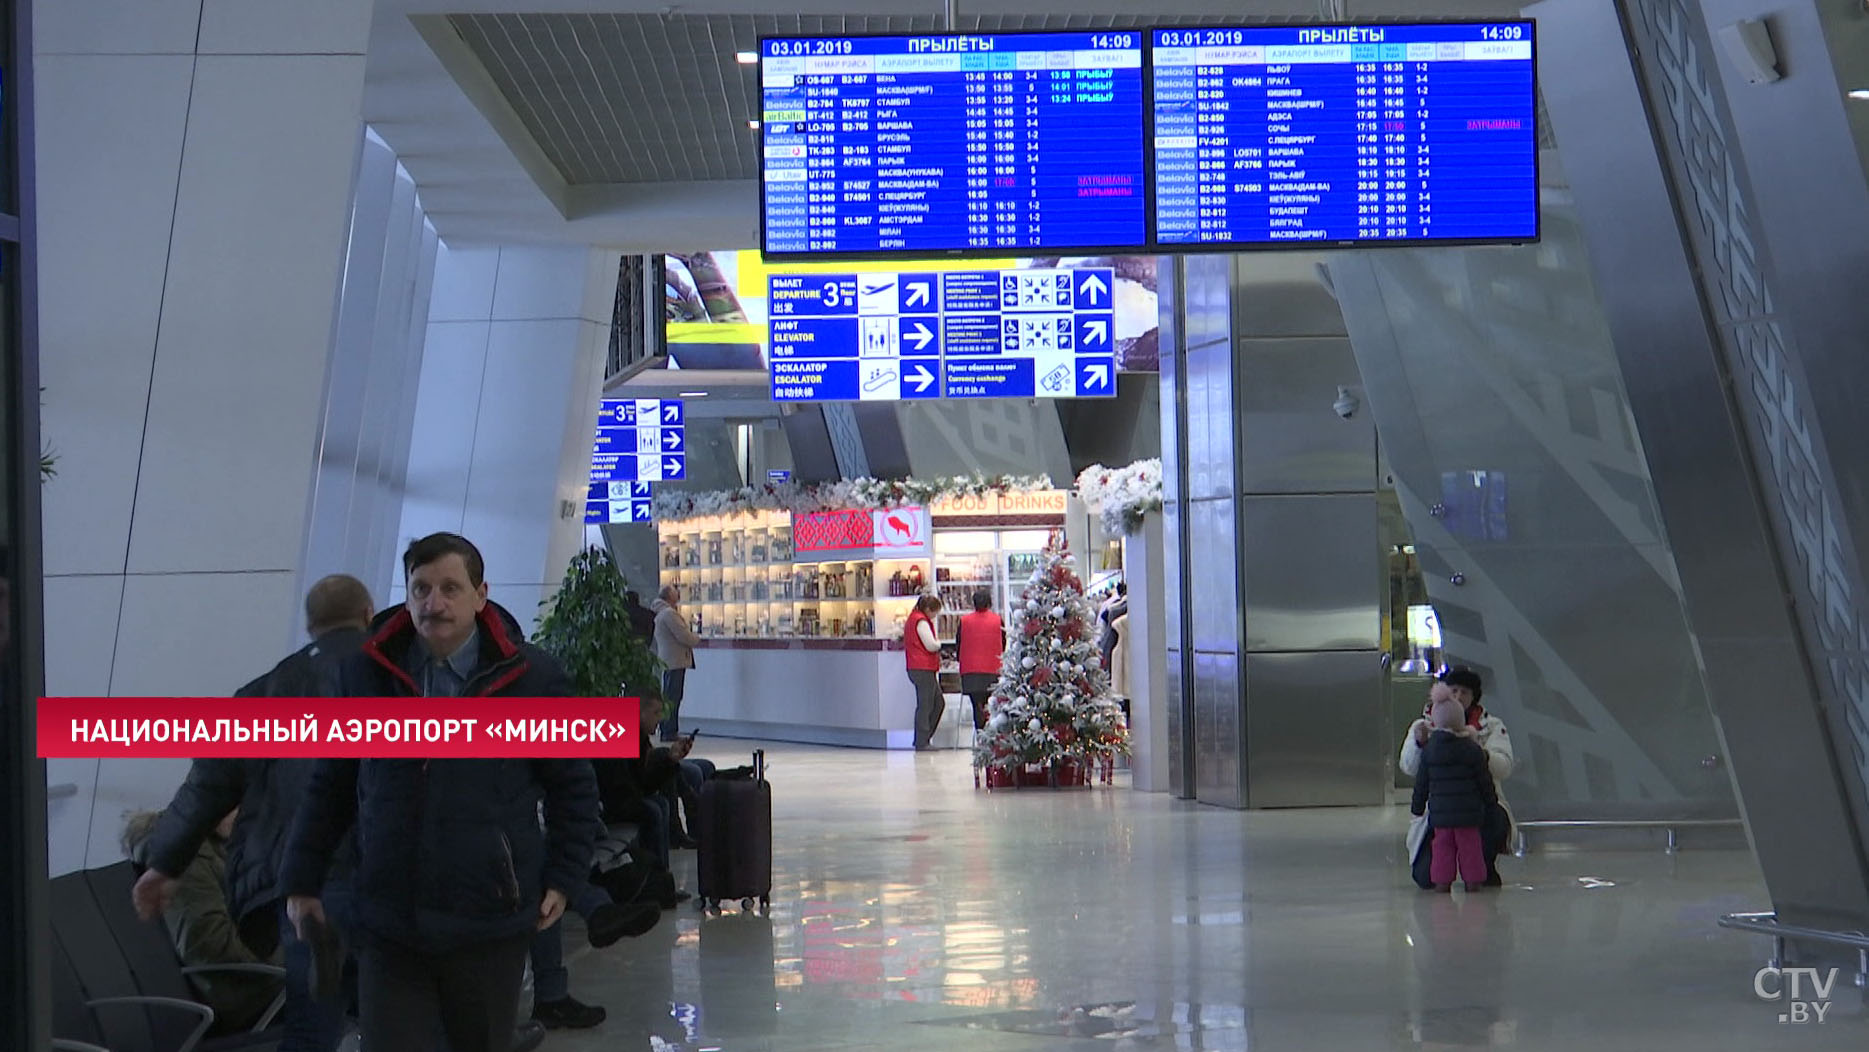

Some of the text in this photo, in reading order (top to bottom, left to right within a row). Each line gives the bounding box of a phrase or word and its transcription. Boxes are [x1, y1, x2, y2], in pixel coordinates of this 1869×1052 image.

[1161, 25, 1521, 45] 03.01.2019 ПРЫЛЁТЫ 14:09
[771, 35, 1132, 55] 03.01.2019 ПРЫЛЁТЫ 14:09
[1076, 69, 1113, 78] ПРЫБЫЎ
[1156, 68, 1193, 77] Belavia
[1076, 80, 1113, 90] ПРЫБЫЎ
[1156, 80, 1193, 89] Belavia
[766, 100, 803, 109] Belavia
[1026, 95, 1037, 103] 3-4
[1077, 92, 1113, 102] ПРЫБЫЎ
[1156, 92, 1193, 101] Belavia
[1027, 107, 1038, 115] 3-4
[1157, 115, 1194, 124] Belavia
[770, 123, 790, 134] LOT
[1027, 119, 1038, 127] 3-4
[1157, 127, 1194, 136] Belavia
[767, 136, 804, 145] Belavia
[1028, 131, 1038, 139] 1-2
[1158, 151, 1194, 160] Belavia
[768, 159, 804, 168] Belavia
[1027, 154, 1038, 162] 3-4
[1158, 163, 1195, 171] Belavia
[1158, 174, 1195, 183] Belavia
[768, 183, 805, 192] Belavia
[1158, 186, 1195, 195] Belavia
[768, 195, 805, 204] Belavia
[1158, 198, 1195, 207] Belavia
[768, 207, 805, 216] Belavia
[1029, 201, 1039, 209] 1-2
[1159, 210, 1196, 218] Belavia
[769, 219, 806, 227] Belavia
[1029, 213, 1040, 221] 1-2
[1159, 221, 1196, 230] Belavia
[769, 230, 806, 239] Belavia
[1029, 225, 1040, 233] 3-4
[769, 242, 806, 251] Belavia
[1030, 237, 1040, 245] 1-2
[773, 278, 802, 288] ВЫЛЕТ
[773, 290, 821, 299] DEPARTURE
[823, 282, 839, 307] 3
[774, 321, 798, 329] ЛИФТ
[774, 333, 814, 342] ELEVATOR
[775, 363, 827, 372] ЭСКАЛАТОР
[775, 375, 822, 383] ESCALATOR
[948, 374, 1006, 383] Currency exchange
[616, 405, 625, 421] 3
[942, 495, 1064, 511] FOOD DRINKS
